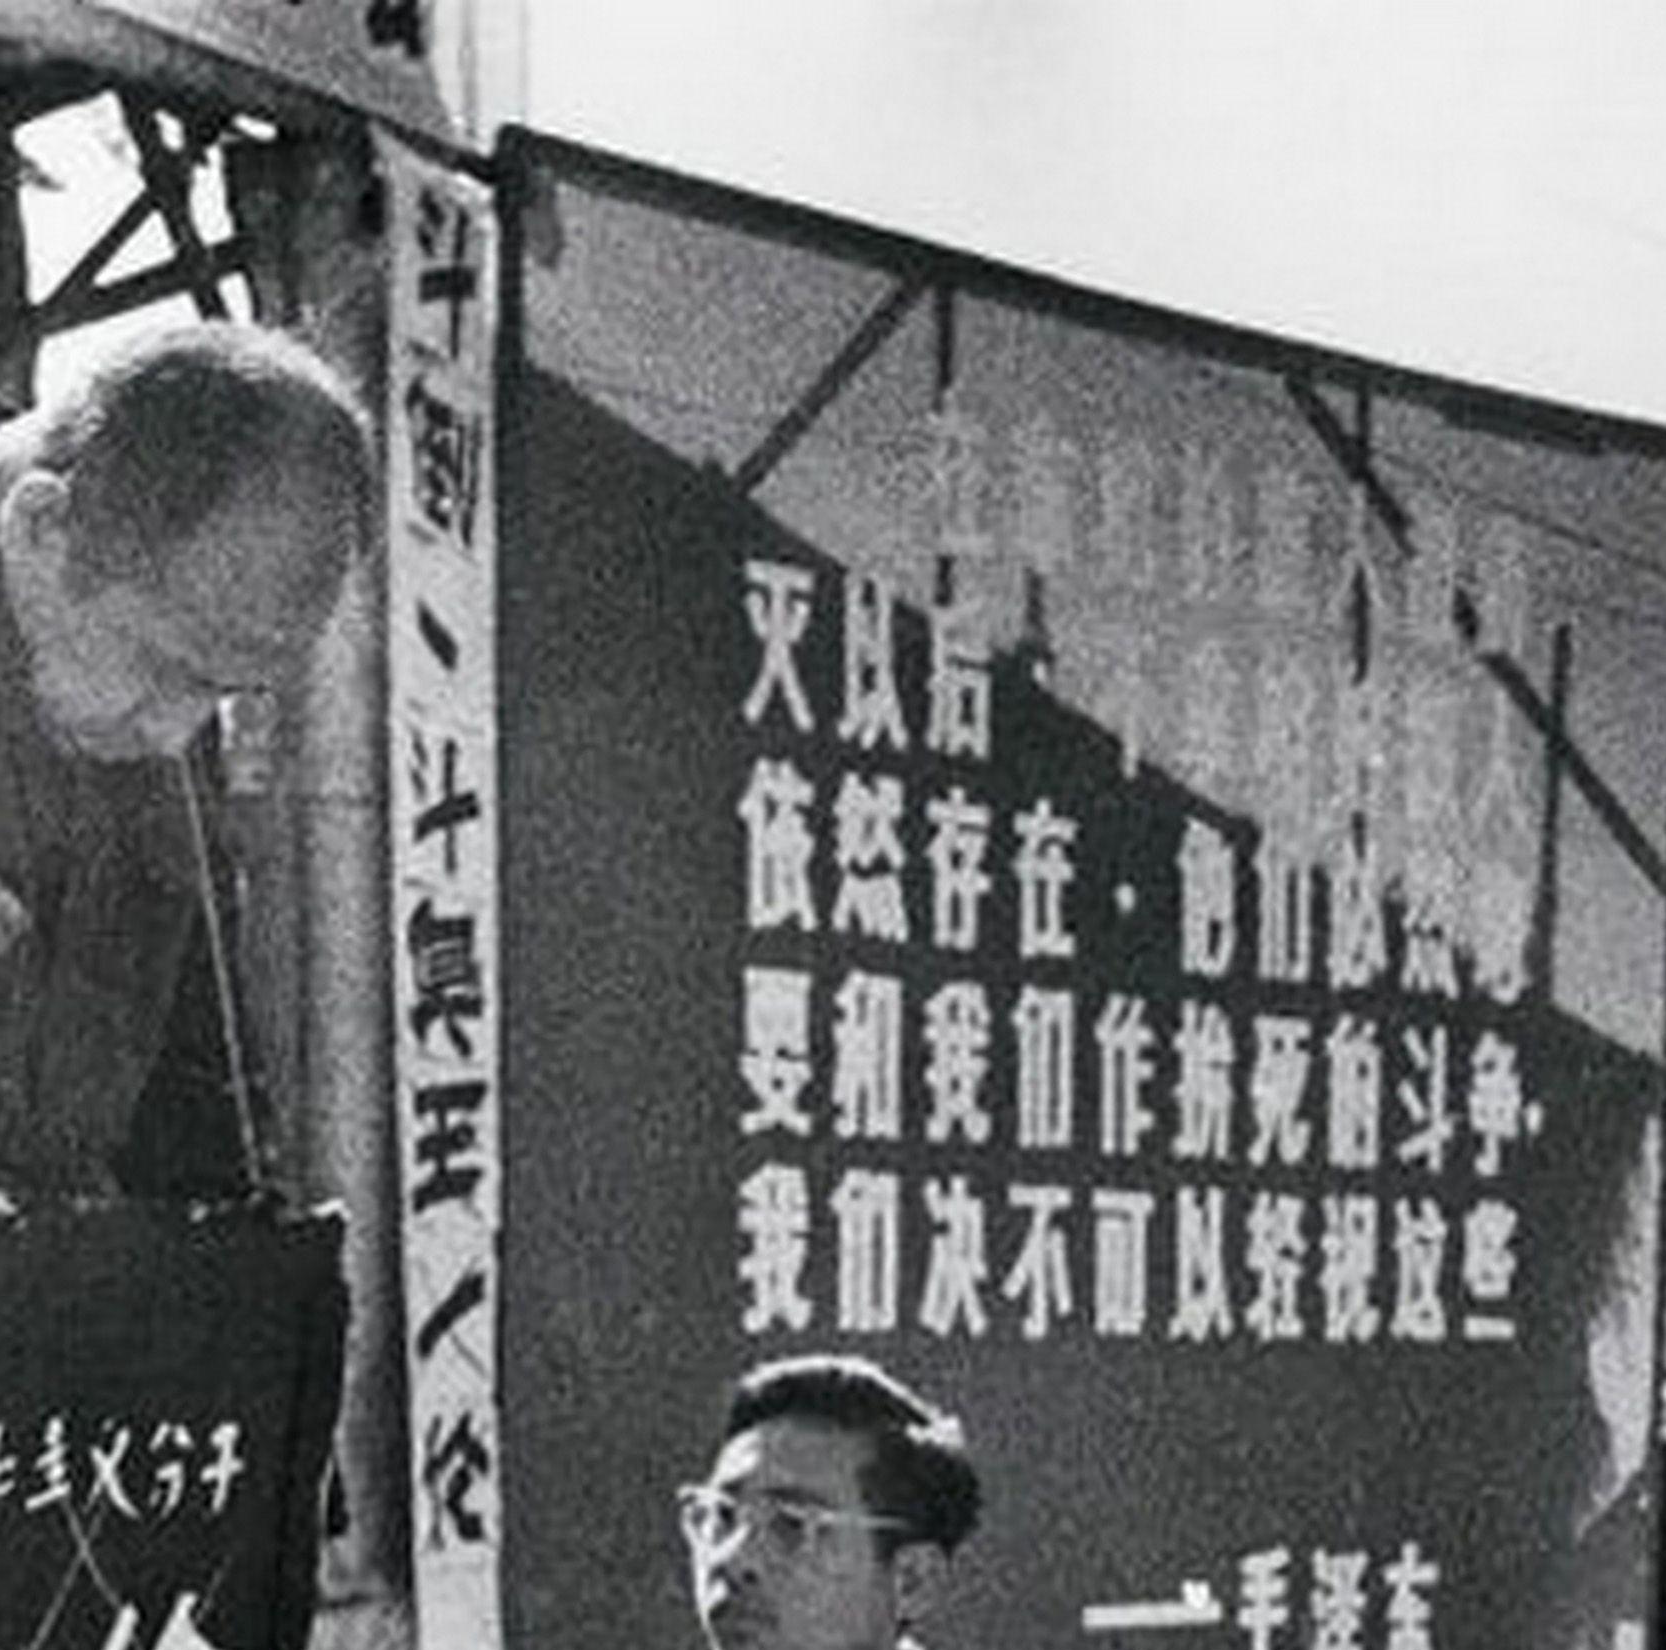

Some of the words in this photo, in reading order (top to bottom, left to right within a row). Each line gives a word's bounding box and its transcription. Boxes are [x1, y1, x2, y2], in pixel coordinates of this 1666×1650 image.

[737, 1162, 1519, 1342] 我们决不可以轻视这些
